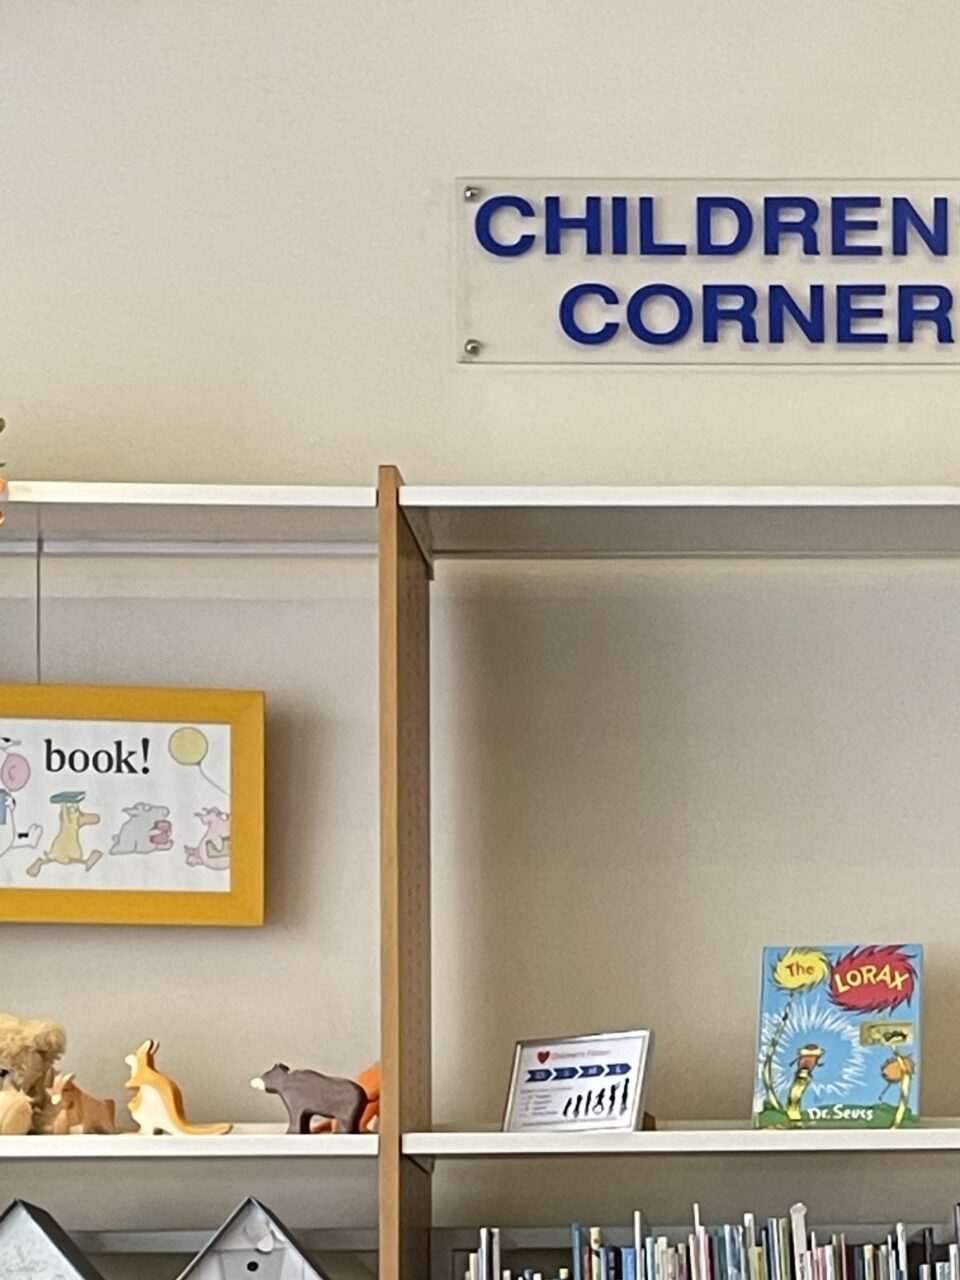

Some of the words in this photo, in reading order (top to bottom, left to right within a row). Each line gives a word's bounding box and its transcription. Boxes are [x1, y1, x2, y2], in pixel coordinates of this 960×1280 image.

[559, 283, 955, 345] CORNER
[44, 737, 150, 775] book!
[786, 961, 815, 978] The
[835, 964, 910, 994] LORAX
[807, 1107, 831, 1120] Dr.
[832, 1104, 873, 1120] Seuss
